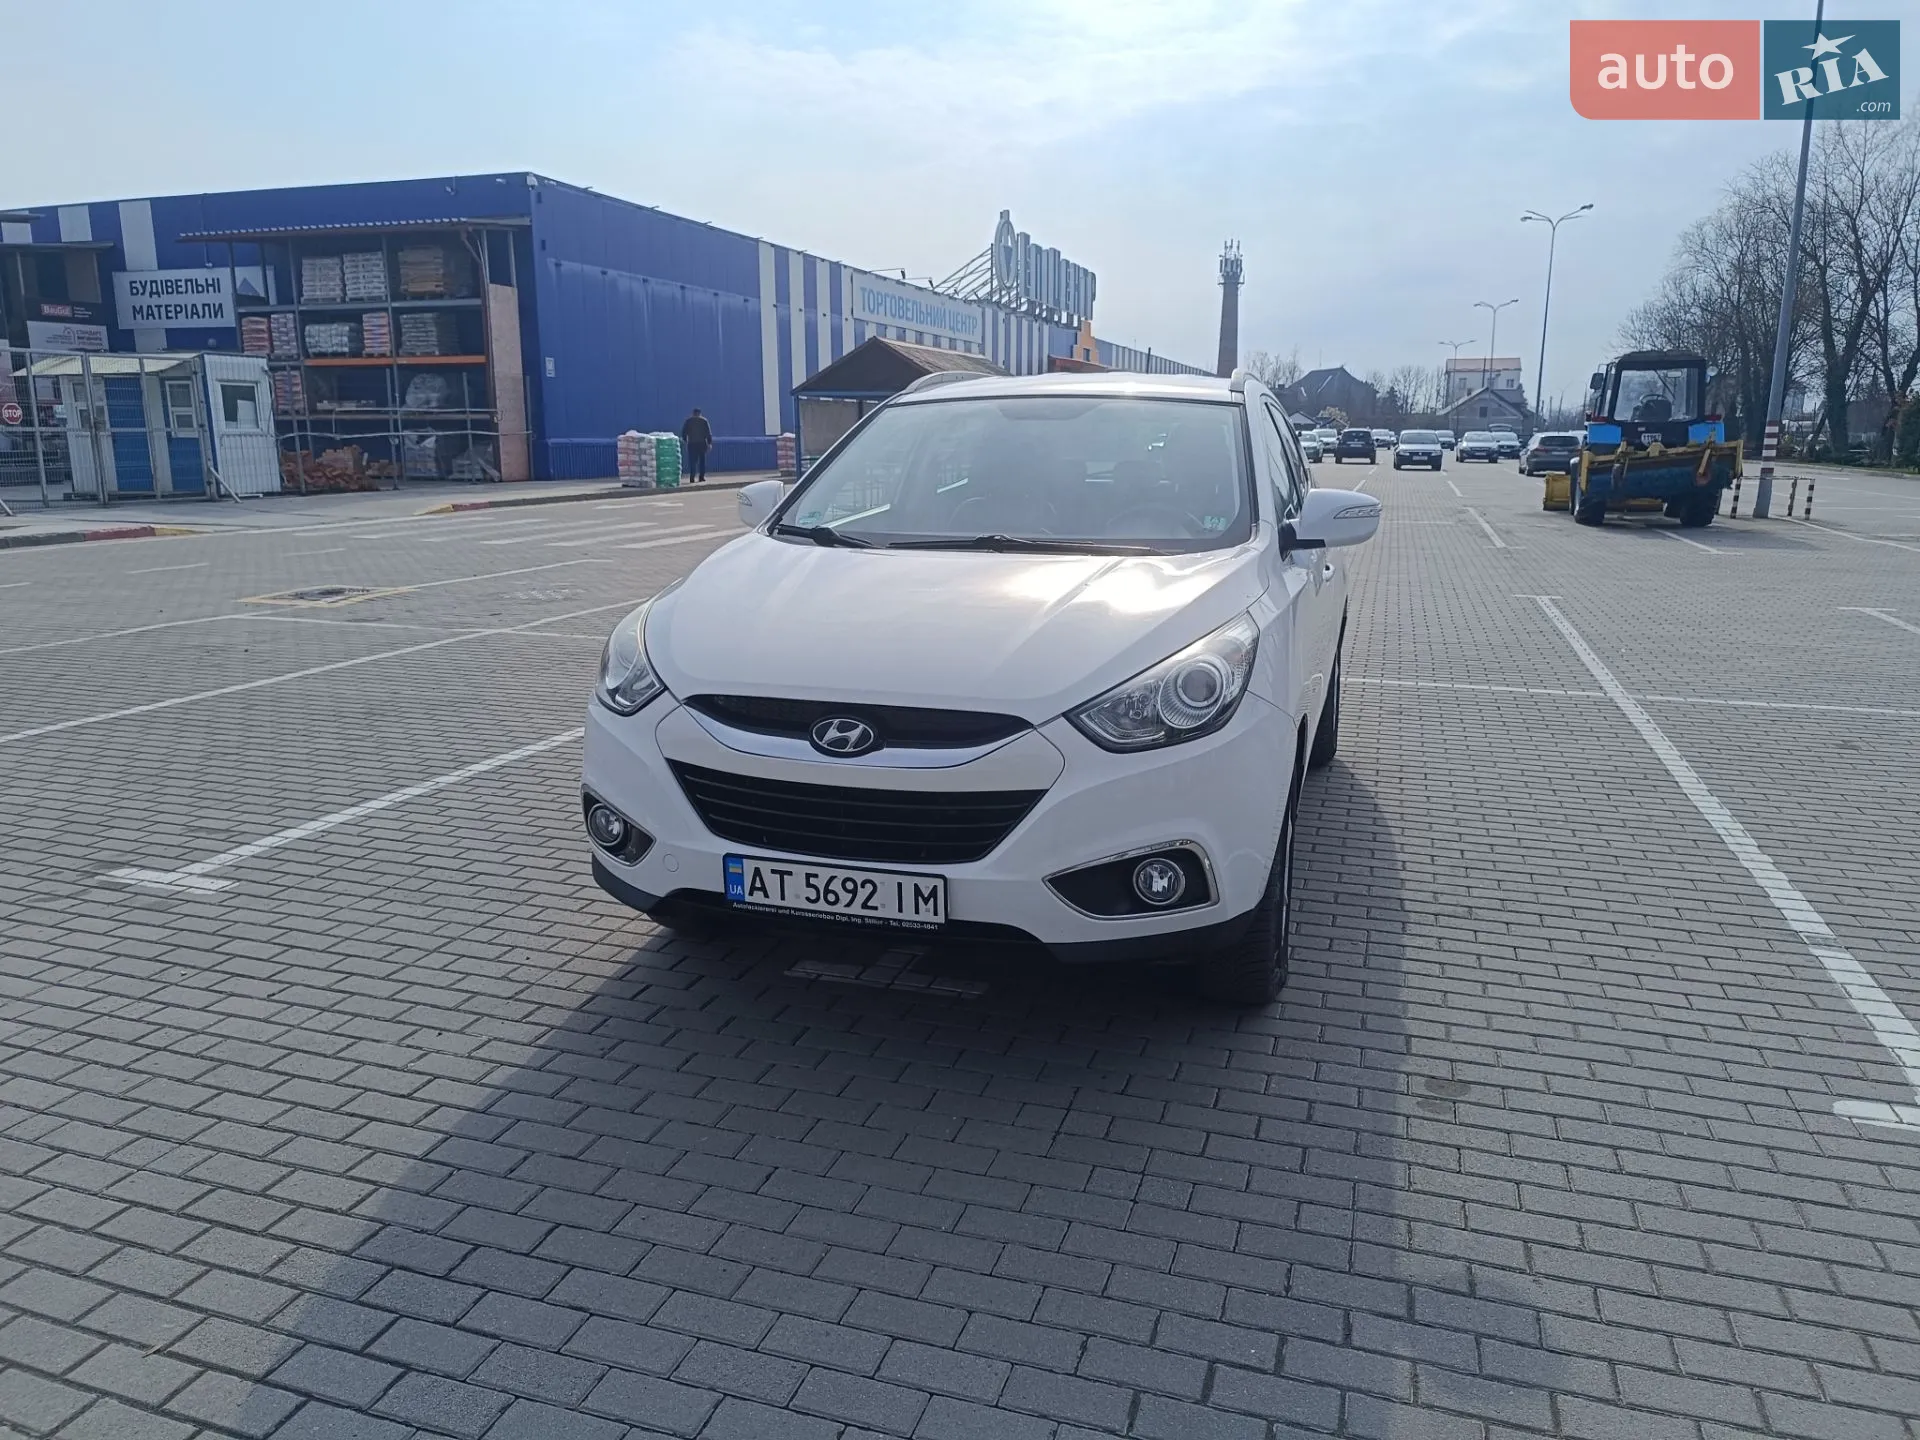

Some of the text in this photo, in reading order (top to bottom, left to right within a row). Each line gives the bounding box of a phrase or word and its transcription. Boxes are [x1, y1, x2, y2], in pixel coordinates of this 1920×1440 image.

[129, 277, 221, 298] БУДІВЕЛЬНІ
[132, 303, 224, 321] МАТЕРІАЛИ
[860, 286, 978, 335] ТОРГОВЕЛЬНИЙ ЦЕНТР
[4, 409, 22, 418] STOP
[730, 884, 743, 896] UA
[748, 866, 939, 917] AT 5692 IM
